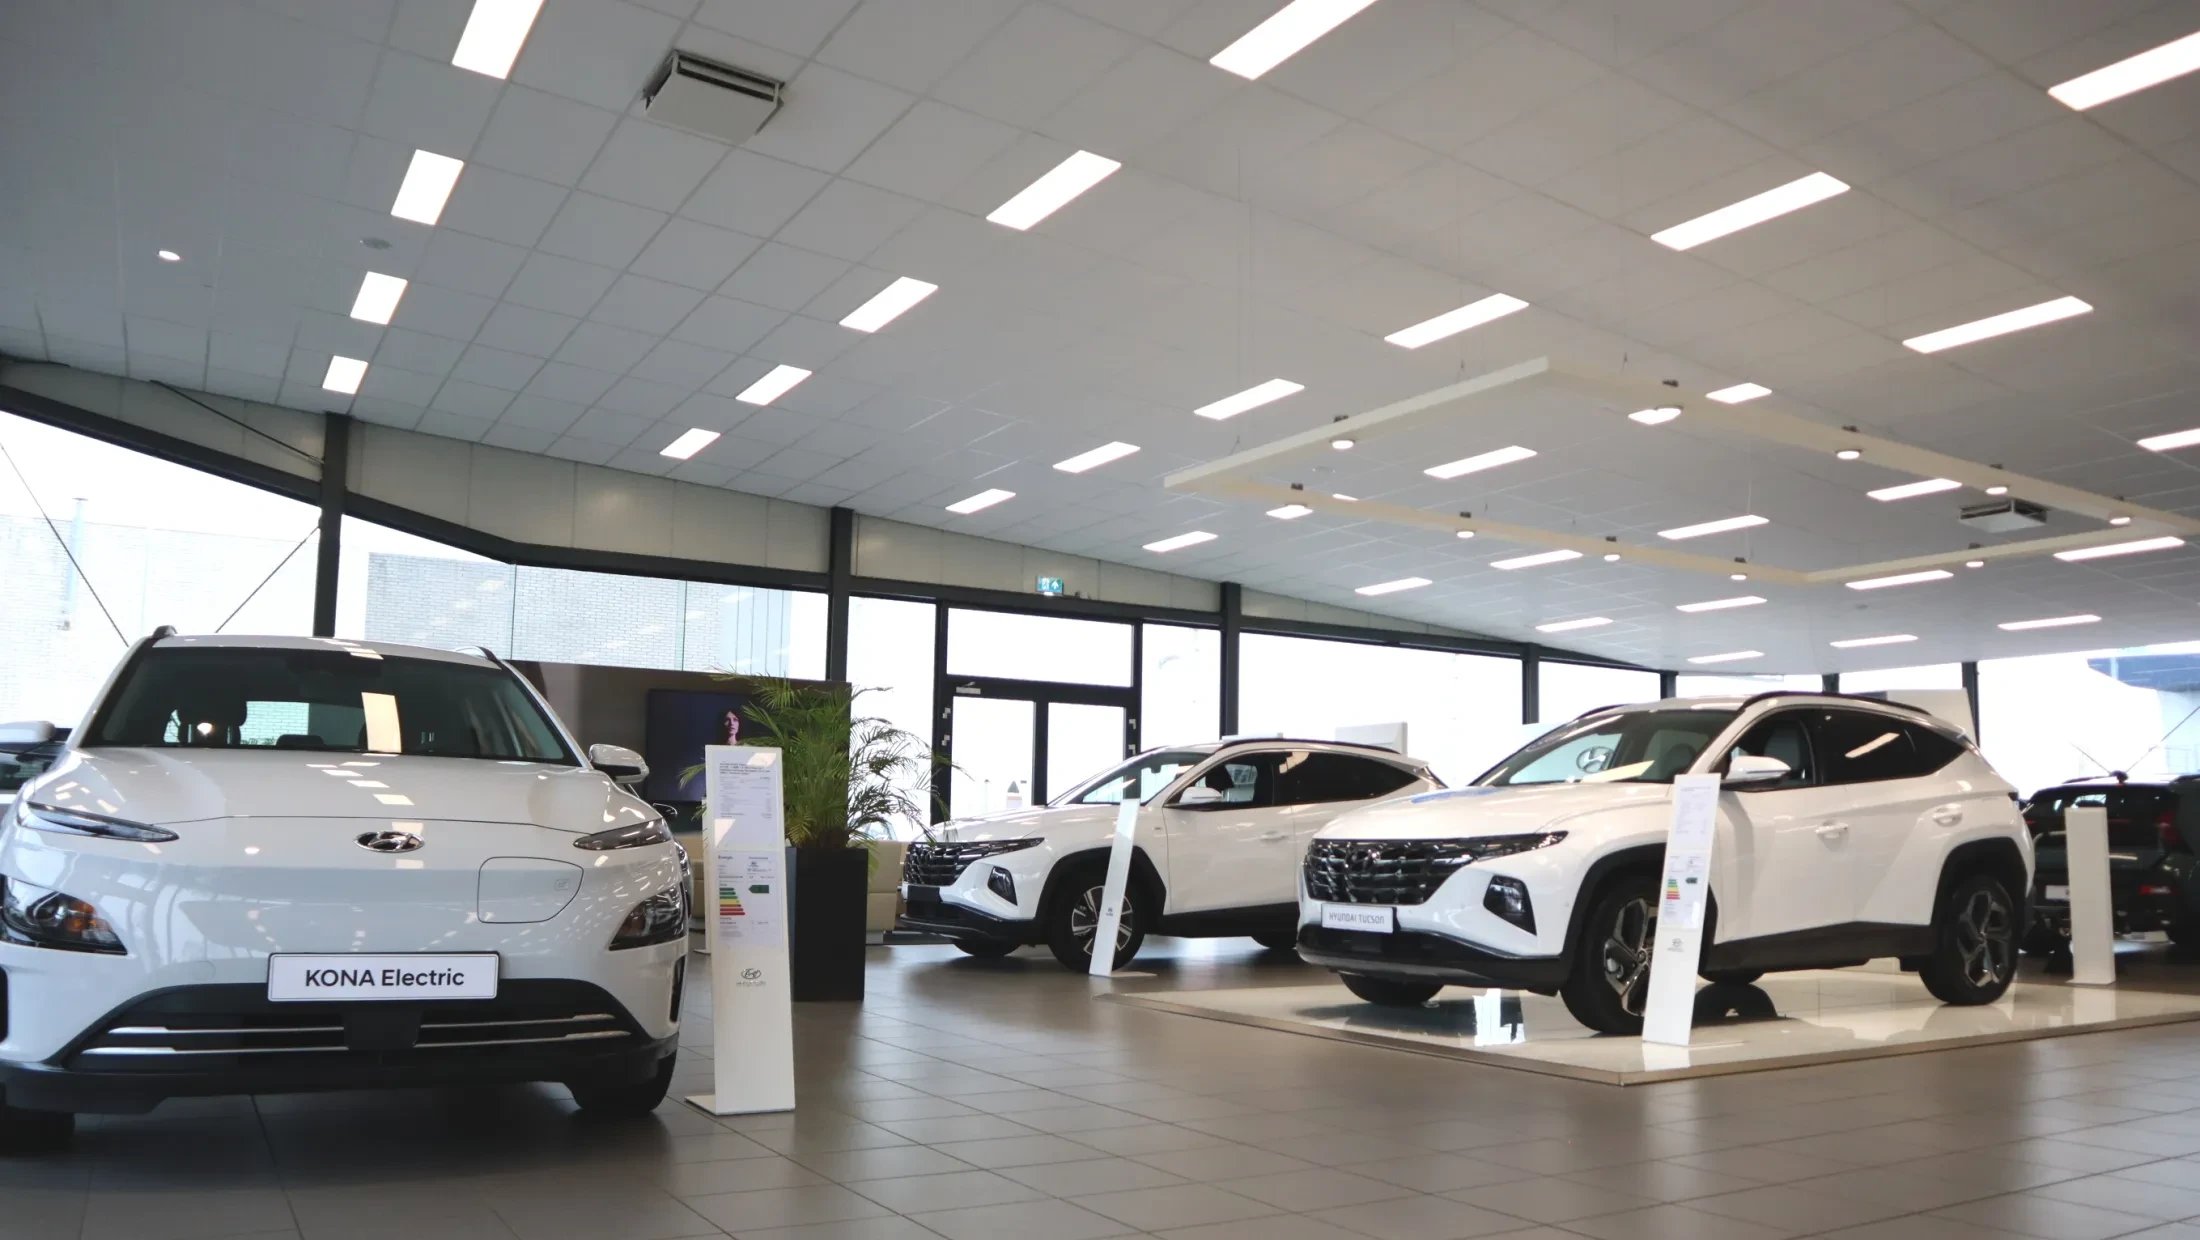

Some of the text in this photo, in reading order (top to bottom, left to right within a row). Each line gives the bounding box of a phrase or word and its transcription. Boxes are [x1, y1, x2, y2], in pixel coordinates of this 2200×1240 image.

[1328, 911, 1385, 925] HYUNDAI TUCSON
[305, 968, 465, 987] KONA Electric
